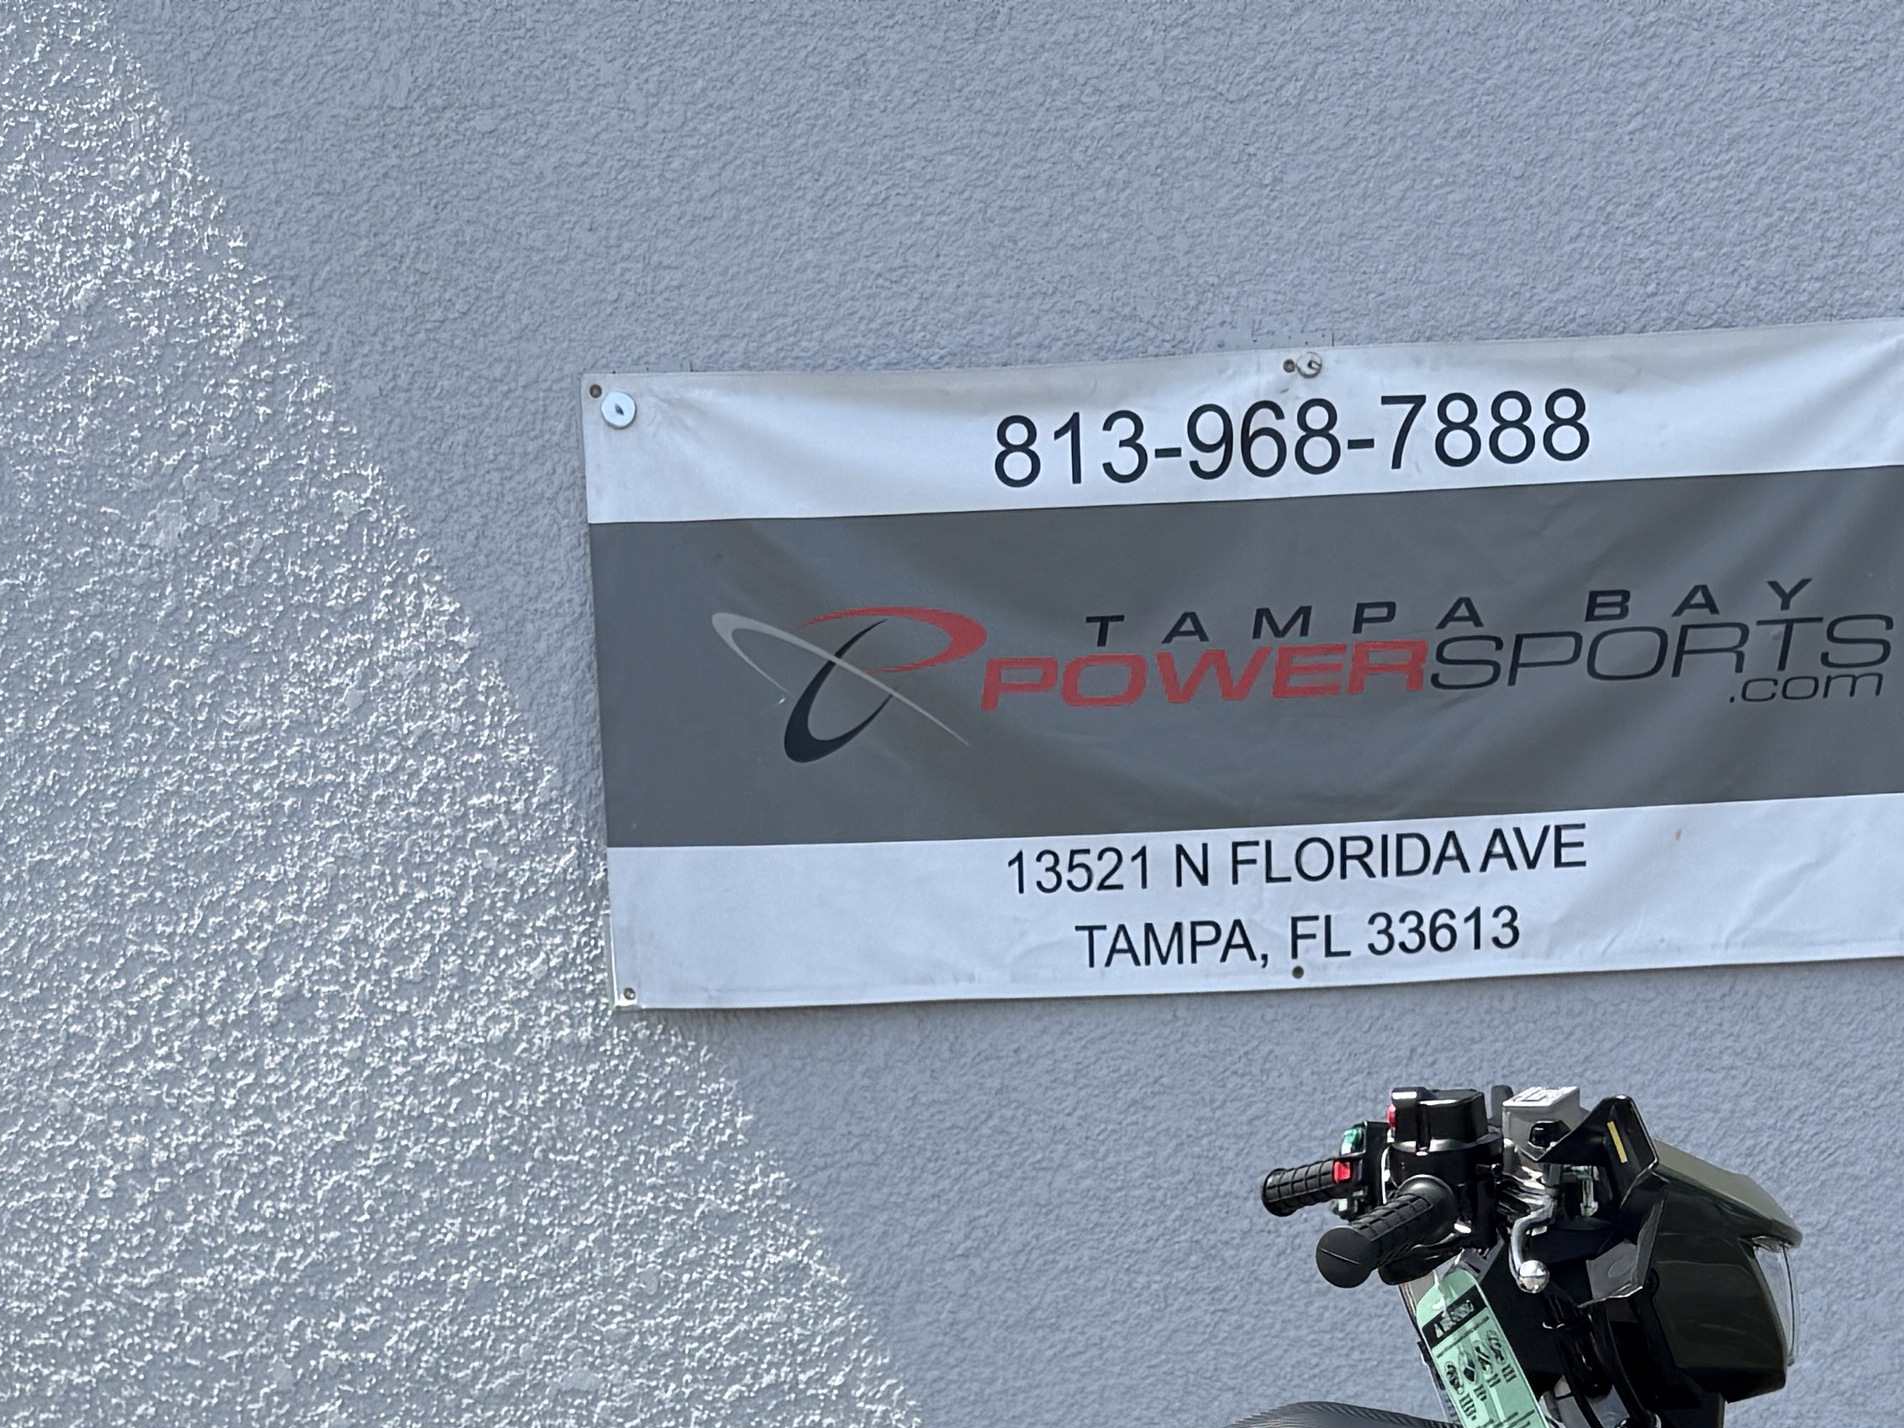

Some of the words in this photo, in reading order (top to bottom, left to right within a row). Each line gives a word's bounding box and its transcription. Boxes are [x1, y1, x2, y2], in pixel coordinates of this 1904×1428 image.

[994, 388, 1590, 488] 813-968-7888
[1086, 596, 1485, 648] TAMPA
[1584, 578, 1813, 622] BAY
[1729, 673, 1884, 703] .com
[1006, 844, 1149, 895] 13521
[1174, 842, 1210, 888] N
[1231, 830, 1471, 885] FLORIDA
[1479, 823, 1587, 873] AVE
[1074, 918, 1269, 969] TAMPA,
[1290, 914, 1351, 959] FL
[1366, 904, 1521, 956] 33613
